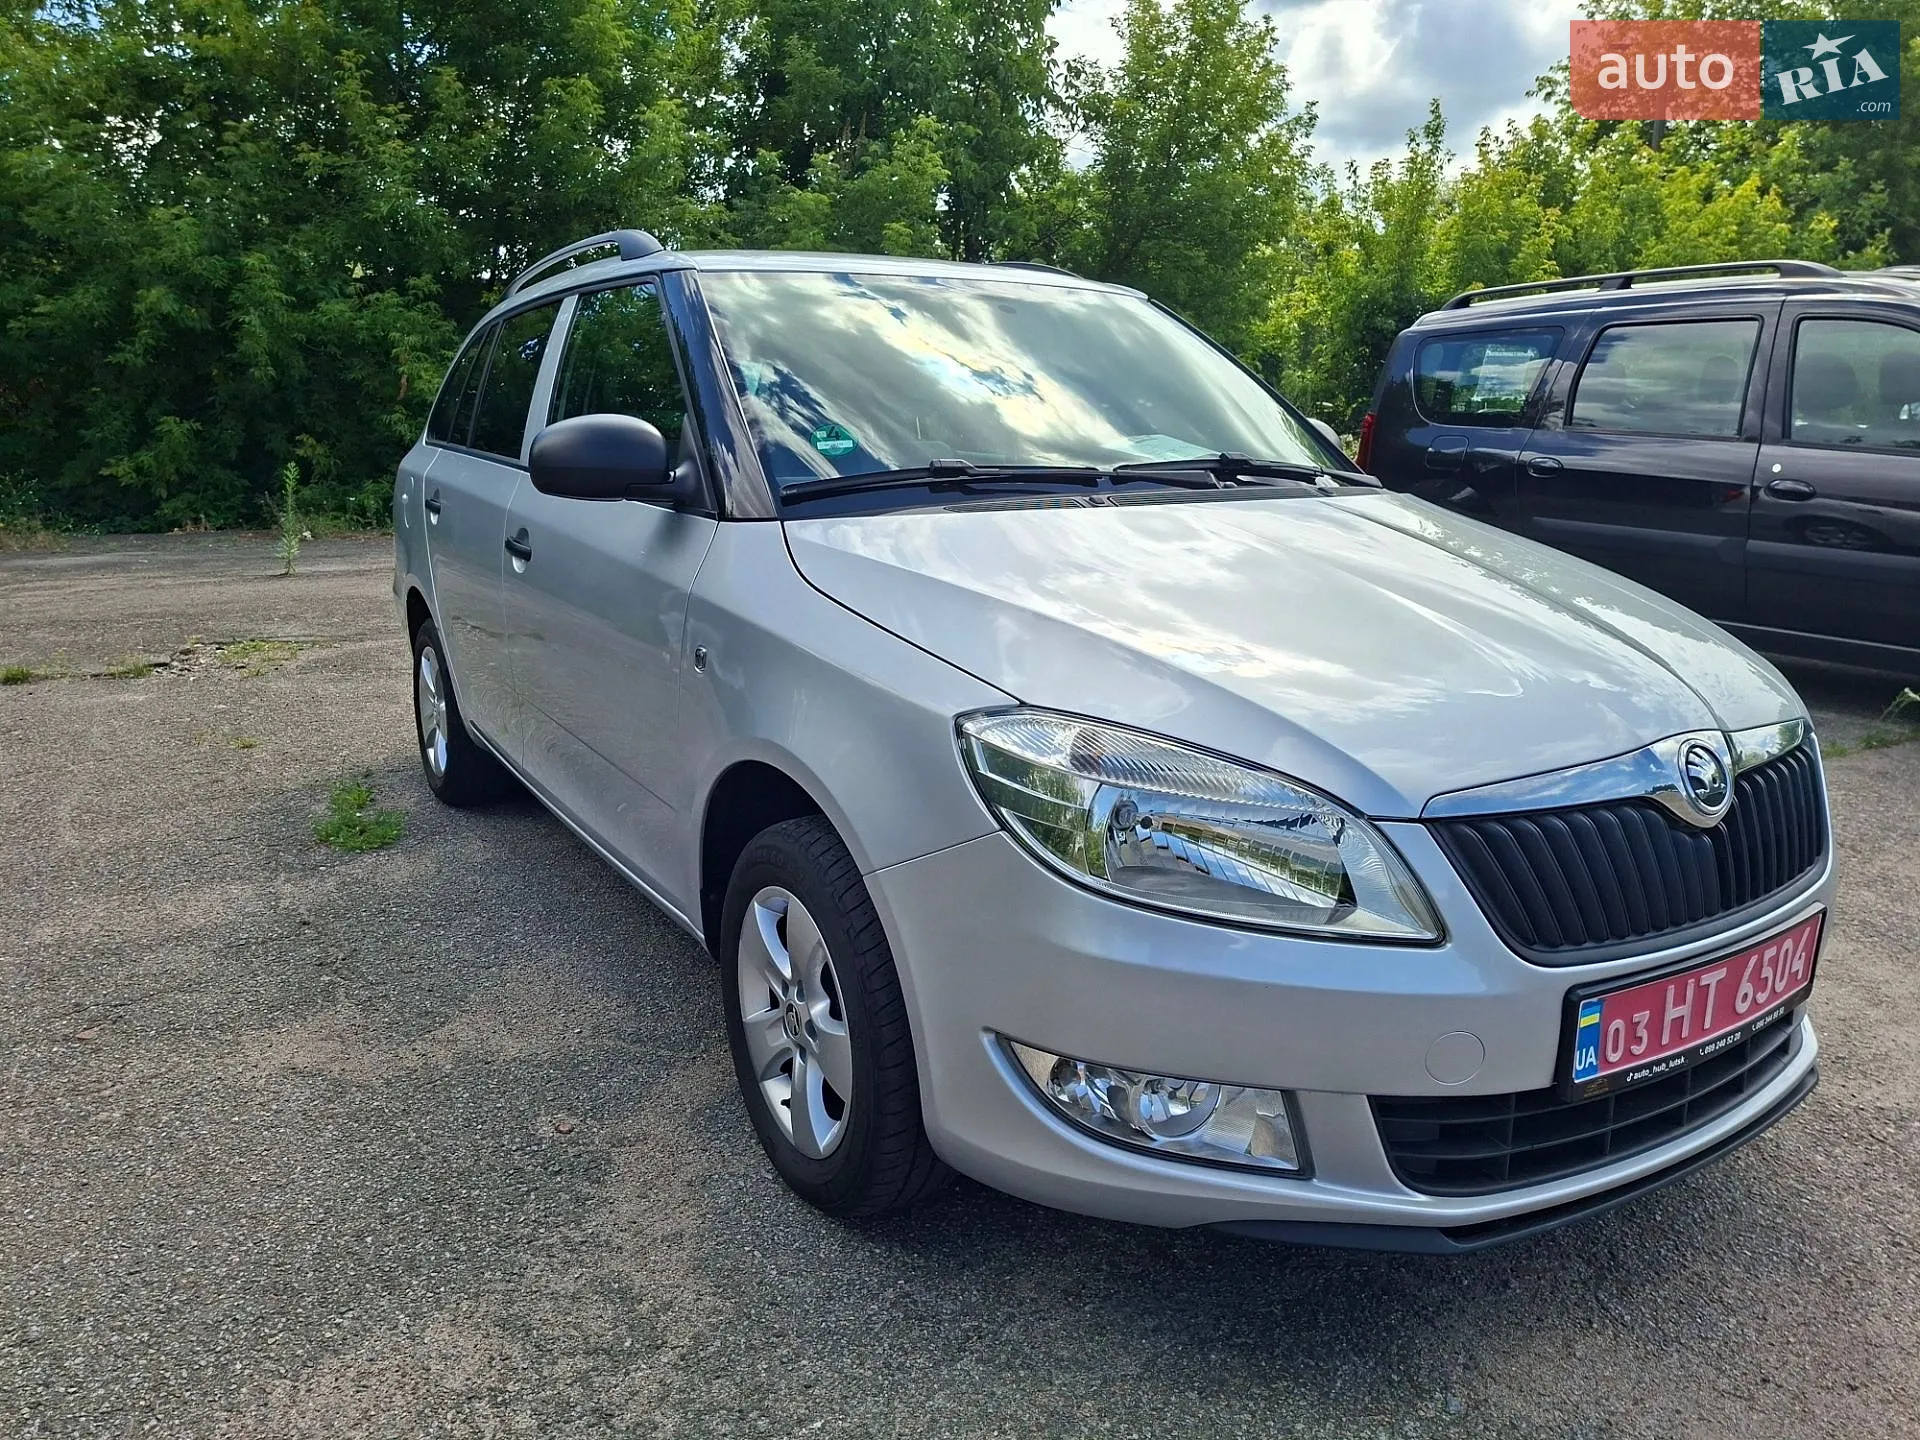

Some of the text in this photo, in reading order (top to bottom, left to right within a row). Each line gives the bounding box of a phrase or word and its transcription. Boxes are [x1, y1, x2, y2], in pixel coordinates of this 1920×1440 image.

[826, 426, 841, 440] 4
[1606, 927, 1811, 1062] 03 HT 6504
[1576, 1047, 1597, 1070] UA
